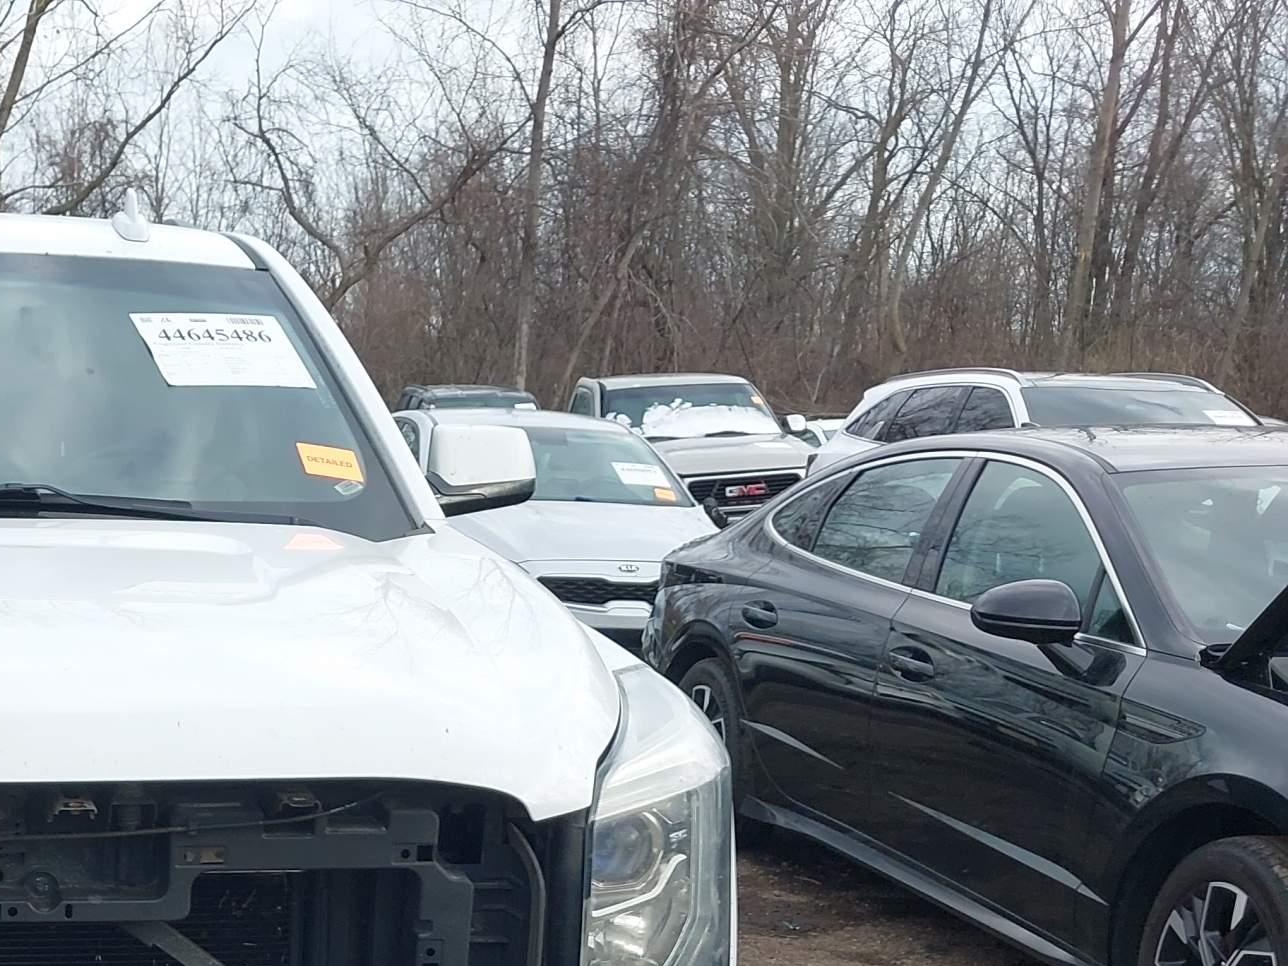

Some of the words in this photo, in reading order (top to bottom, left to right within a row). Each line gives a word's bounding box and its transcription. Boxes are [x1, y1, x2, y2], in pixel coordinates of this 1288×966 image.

[158, 328, 272, 343] 44645486
[306, 455, 353, 468] DETAILED
[725, 483, 767, 497] GMC
